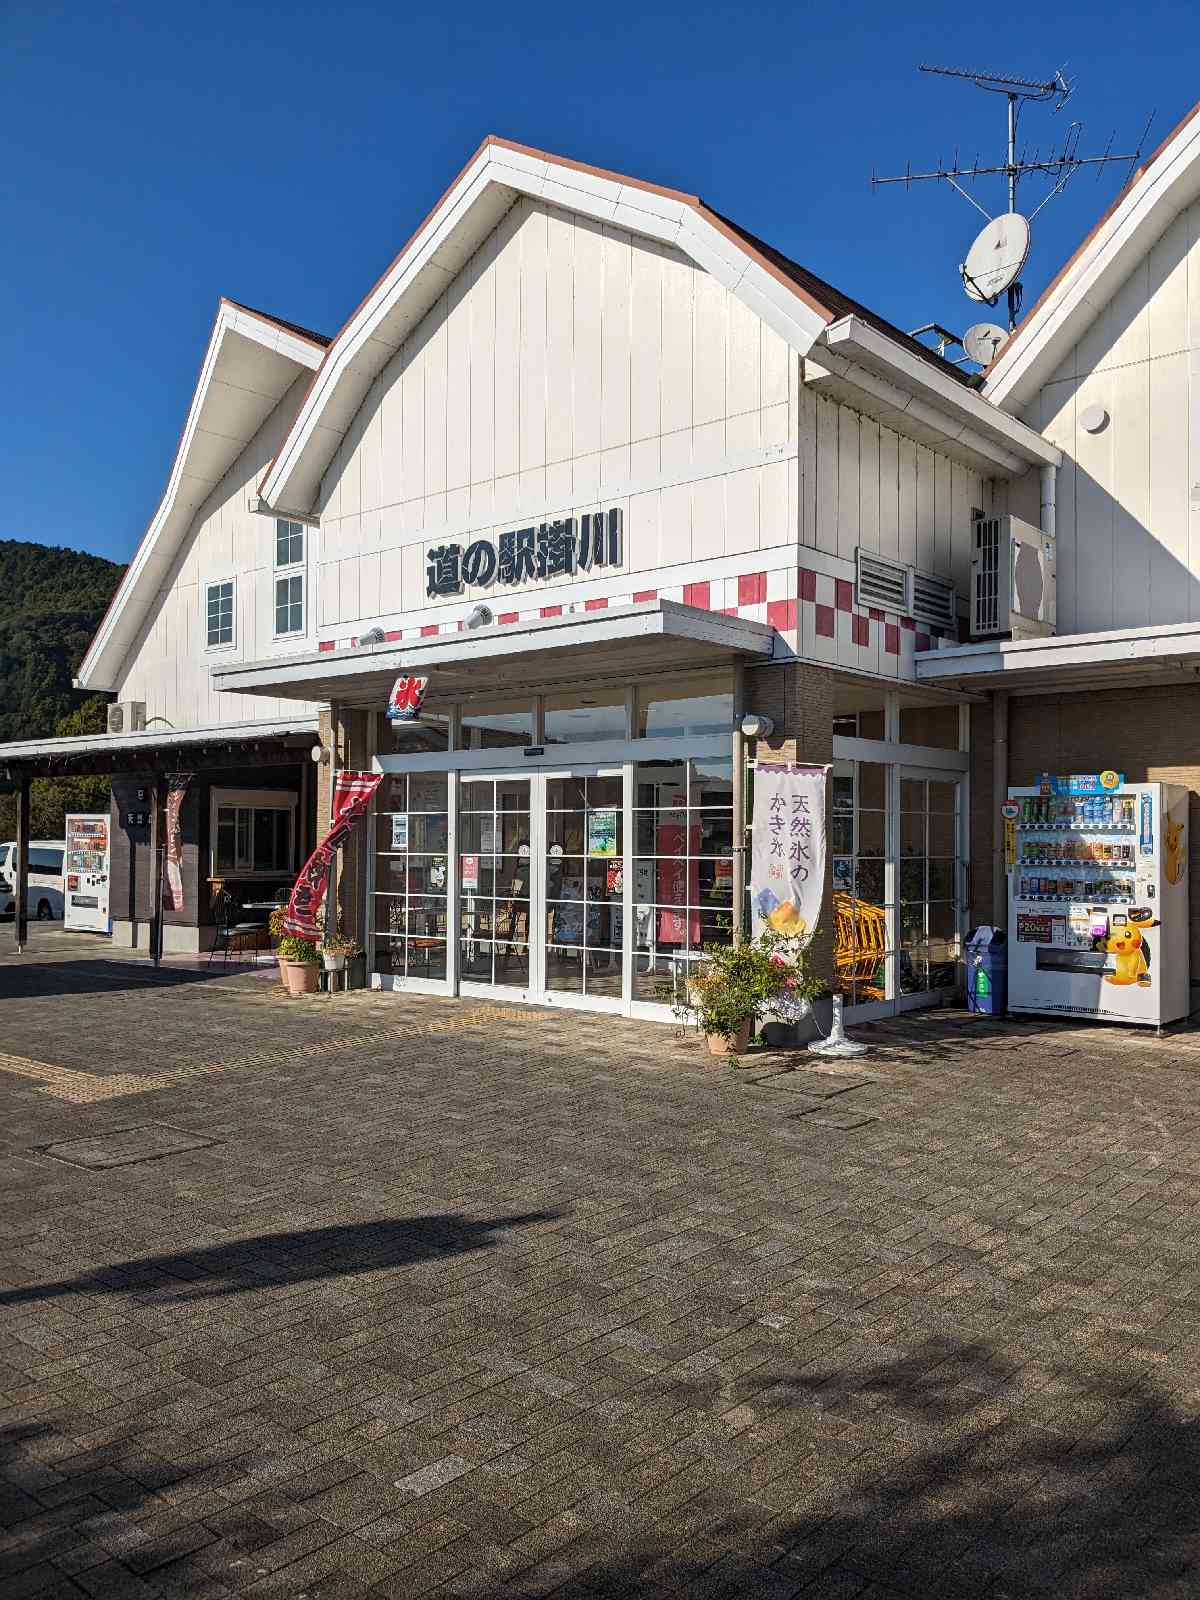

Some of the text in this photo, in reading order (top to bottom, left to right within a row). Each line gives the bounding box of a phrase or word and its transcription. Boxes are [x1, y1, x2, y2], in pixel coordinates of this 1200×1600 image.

[426, 507, 621, 598] 道の駅掛川
[395, 676, 424, 711] 氷
[769, 793, 786, 858] かき氷
[790, 794, 811, 882] 天然氷の
